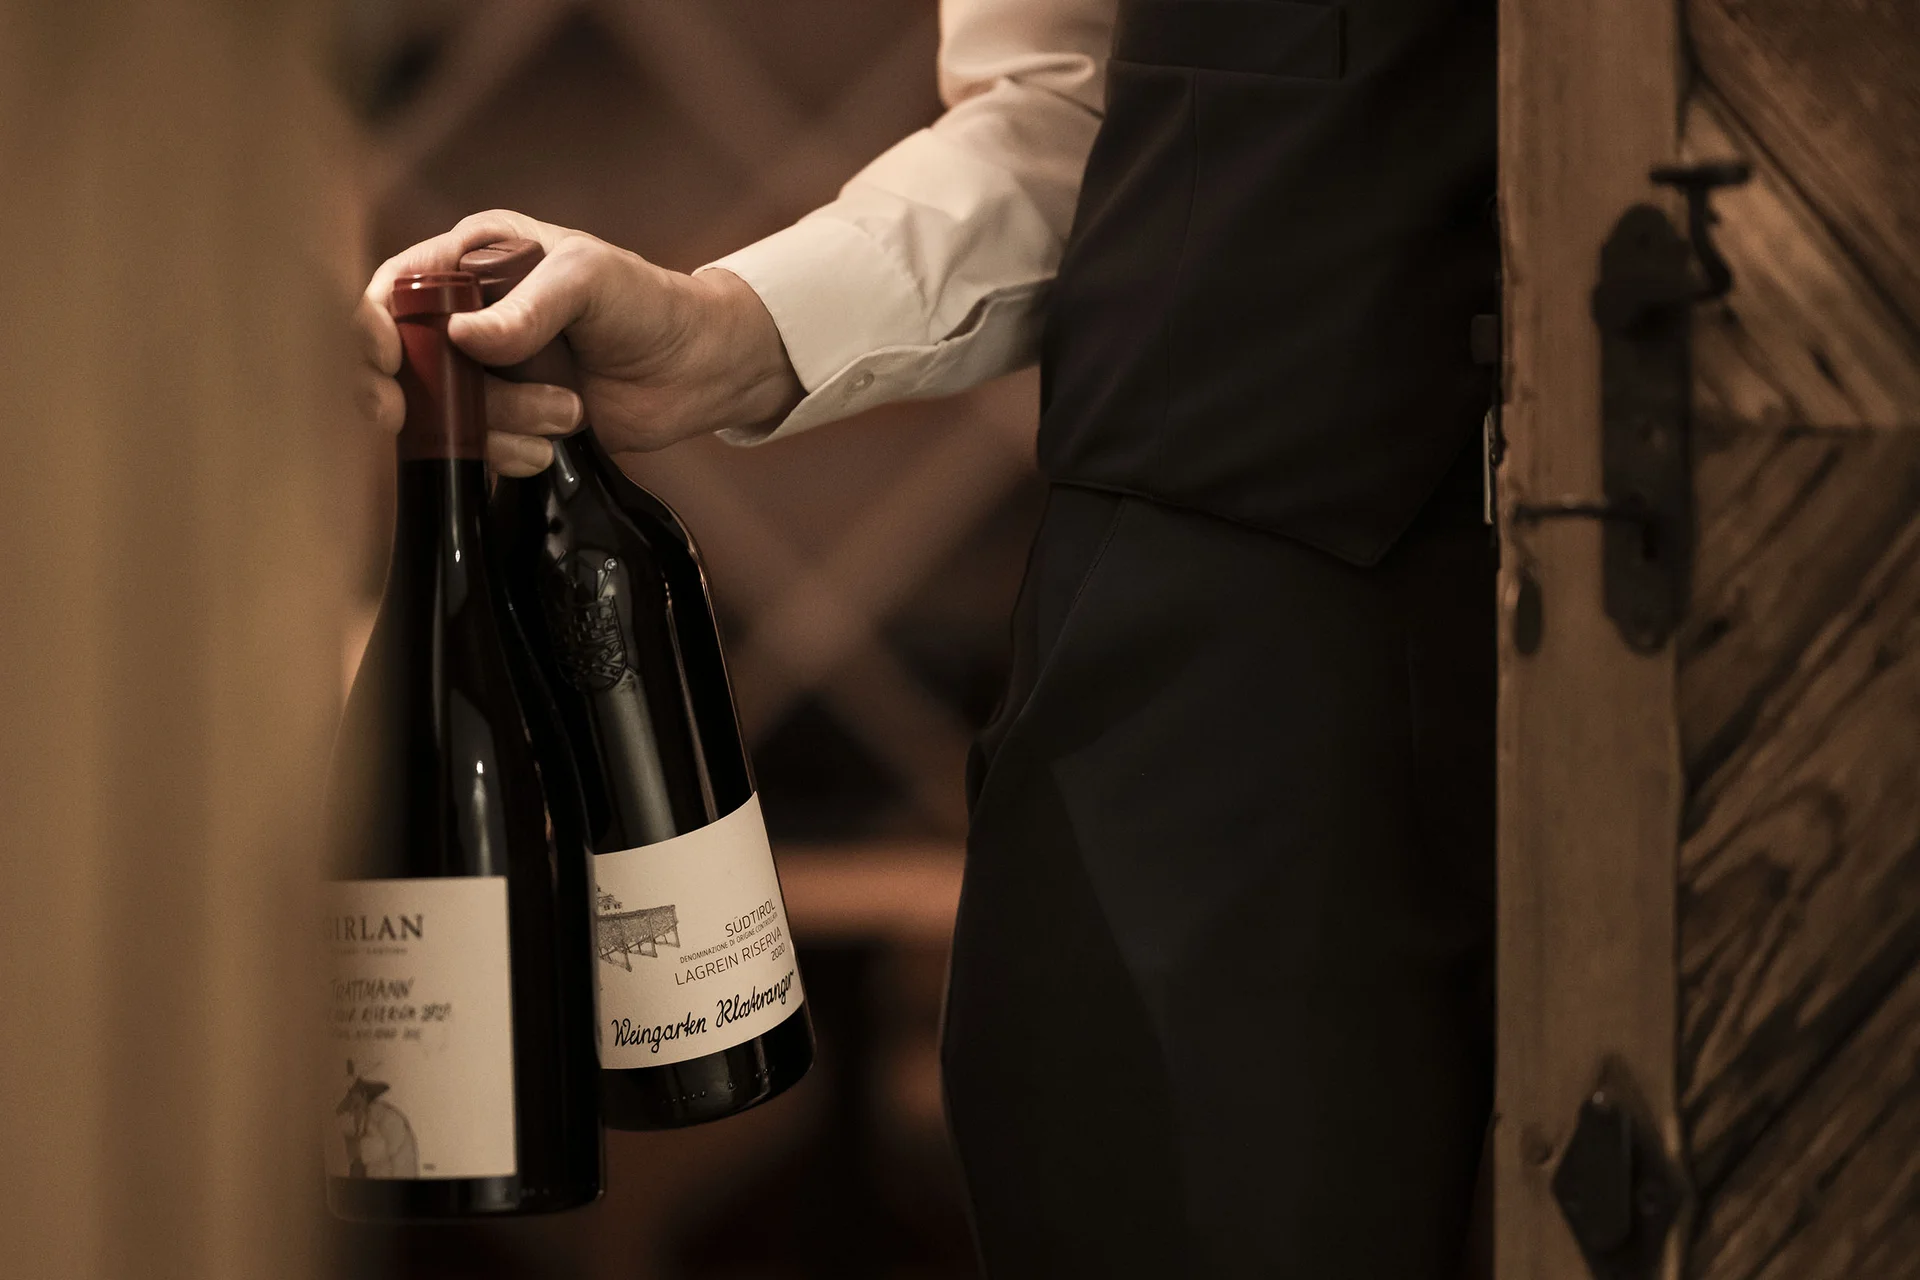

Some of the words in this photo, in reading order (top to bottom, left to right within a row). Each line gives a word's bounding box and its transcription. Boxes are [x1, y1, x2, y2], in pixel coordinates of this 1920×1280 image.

[323, 914, 424, 941] IRLAN
[725, 899, 776, 937] SÜDTIROL
[674, 953, 739, 986] LAGREIN
[741, 926, 782, 962] RISERVA
[680, 943, 728, 964] DENOMINAZIONE
[730, 939, 736, 947] DI
[736, 929, 755, 943] ORIGINE
[770, 942, 786, 962] 2020
[611, 1012, 707, 1053] Weingarten
